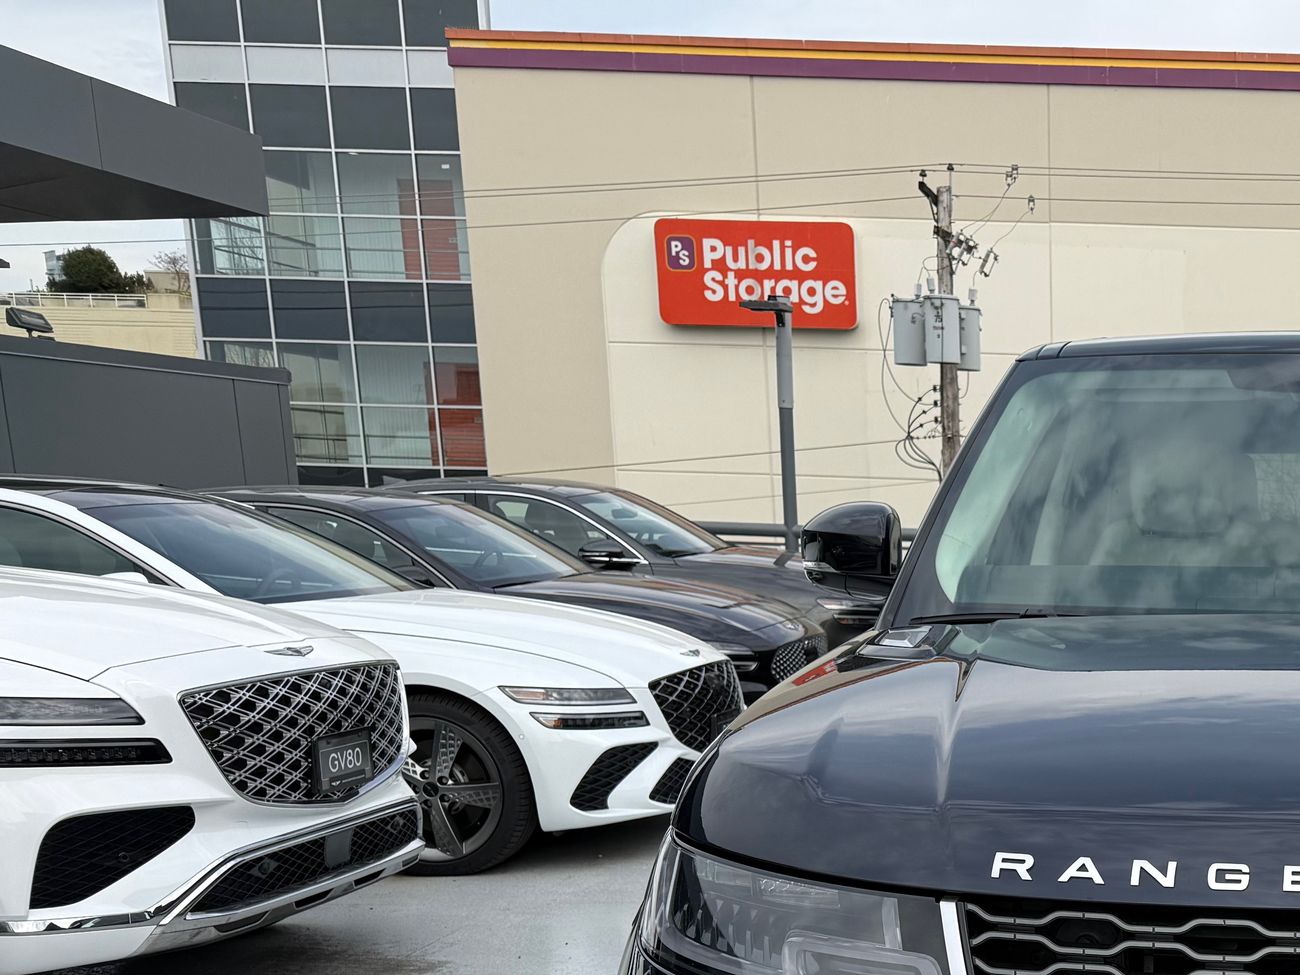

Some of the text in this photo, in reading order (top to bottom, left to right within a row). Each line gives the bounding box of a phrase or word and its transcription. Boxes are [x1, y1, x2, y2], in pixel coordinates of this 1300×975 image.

[670, 240, 690, 266] PS
[702, 238, 818, 272] Public
[703, 270, 848, 314] Storage
[328, 747, 362, 773] GV80
